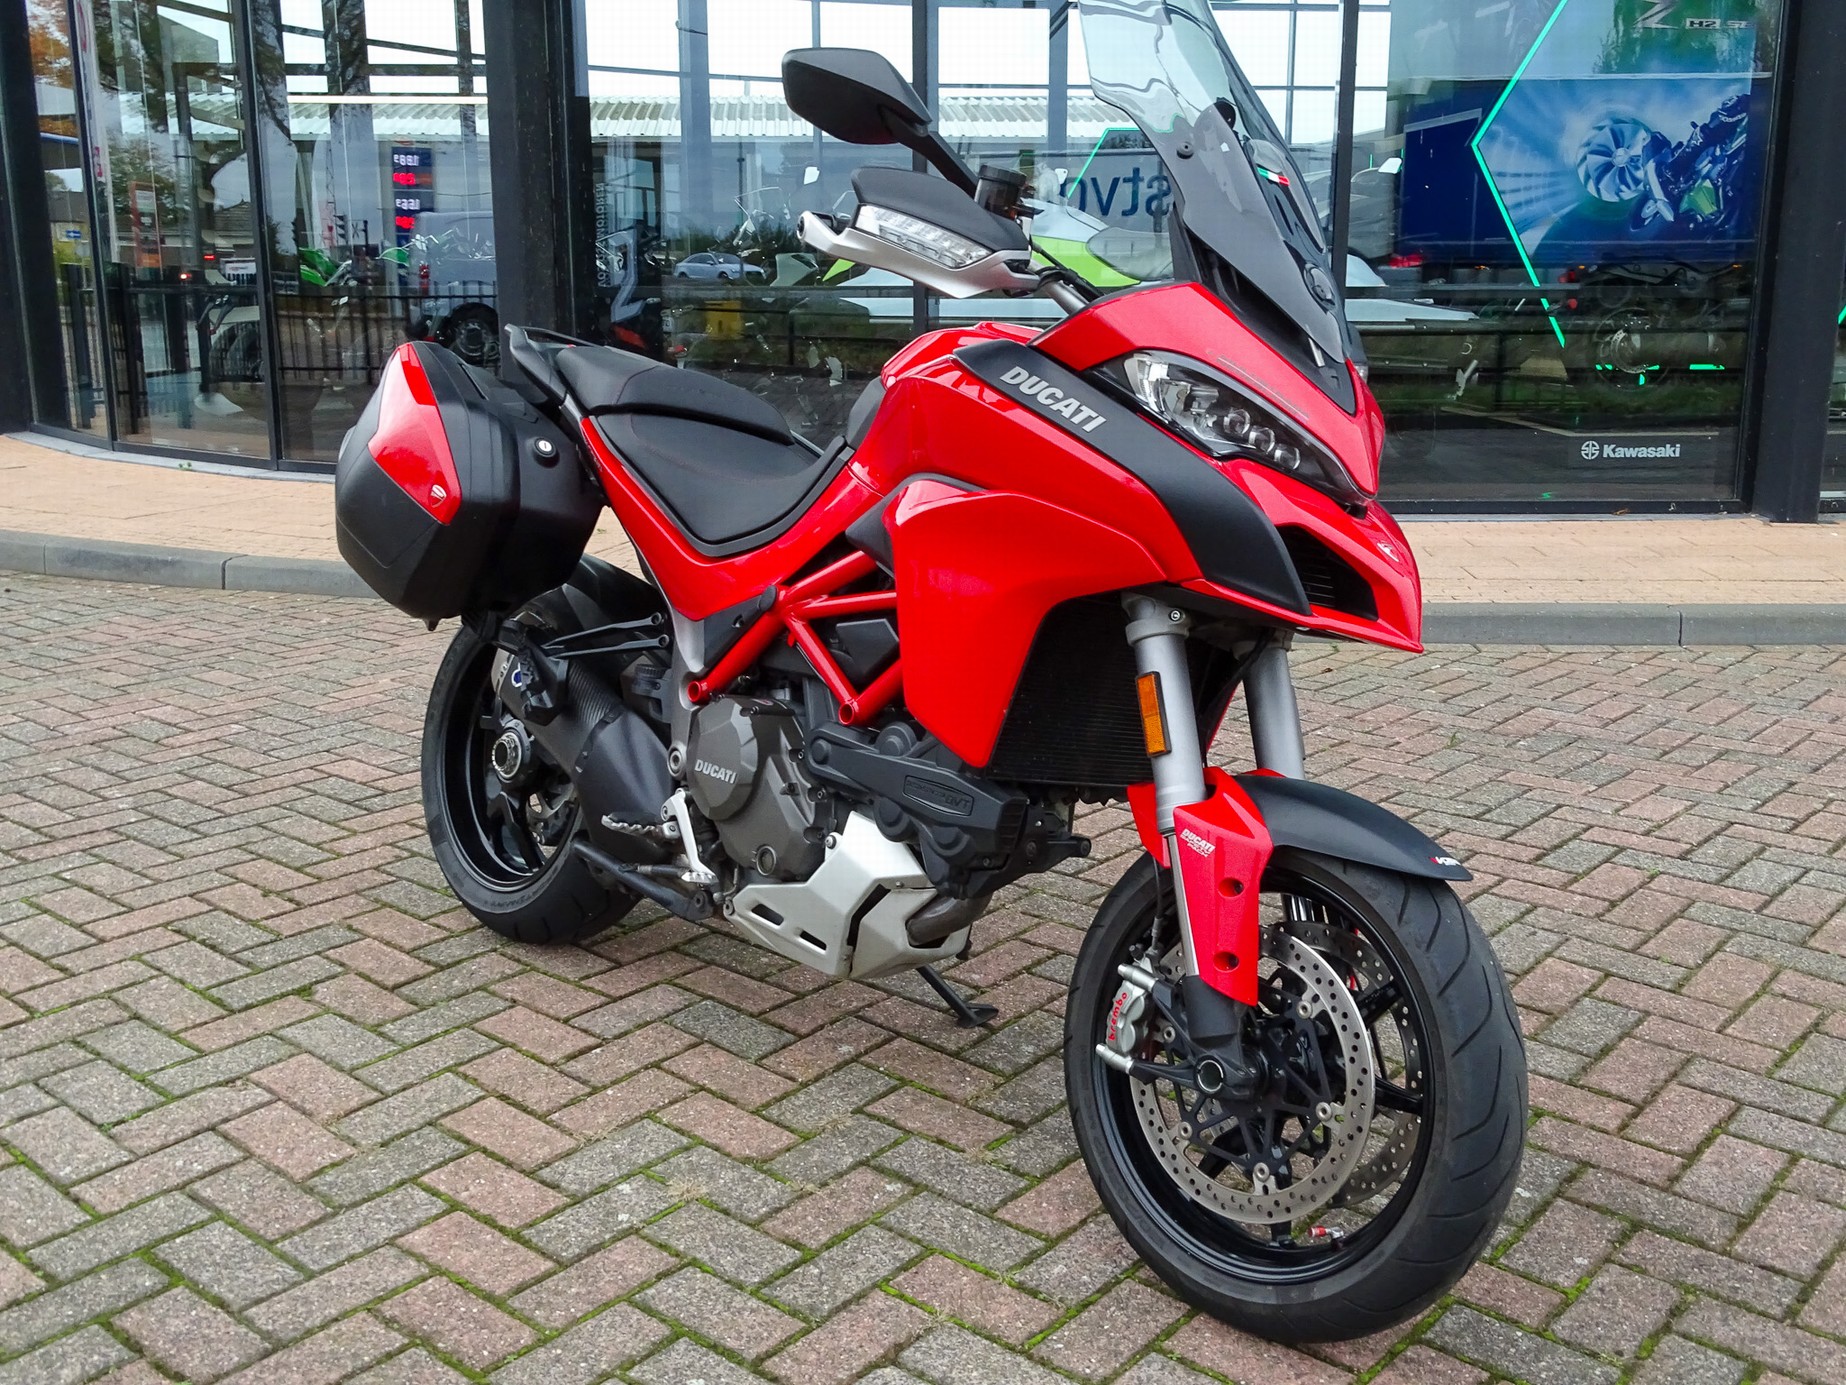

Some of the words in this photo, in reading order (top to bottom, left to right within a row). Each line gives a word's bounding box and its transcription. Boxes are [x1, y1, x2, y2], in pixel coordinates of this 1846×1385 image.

[1688, 20, 1717, 28] H2
[1000, 366, 1106, 432] DUCATI
[1602, 443, 1681, 458] Kawasaki
[694, 759, 737, 784] DUCATI
[1180, 828, 1216, 853] DUCATI
[1108, 992, 1128, 1041] brembo
